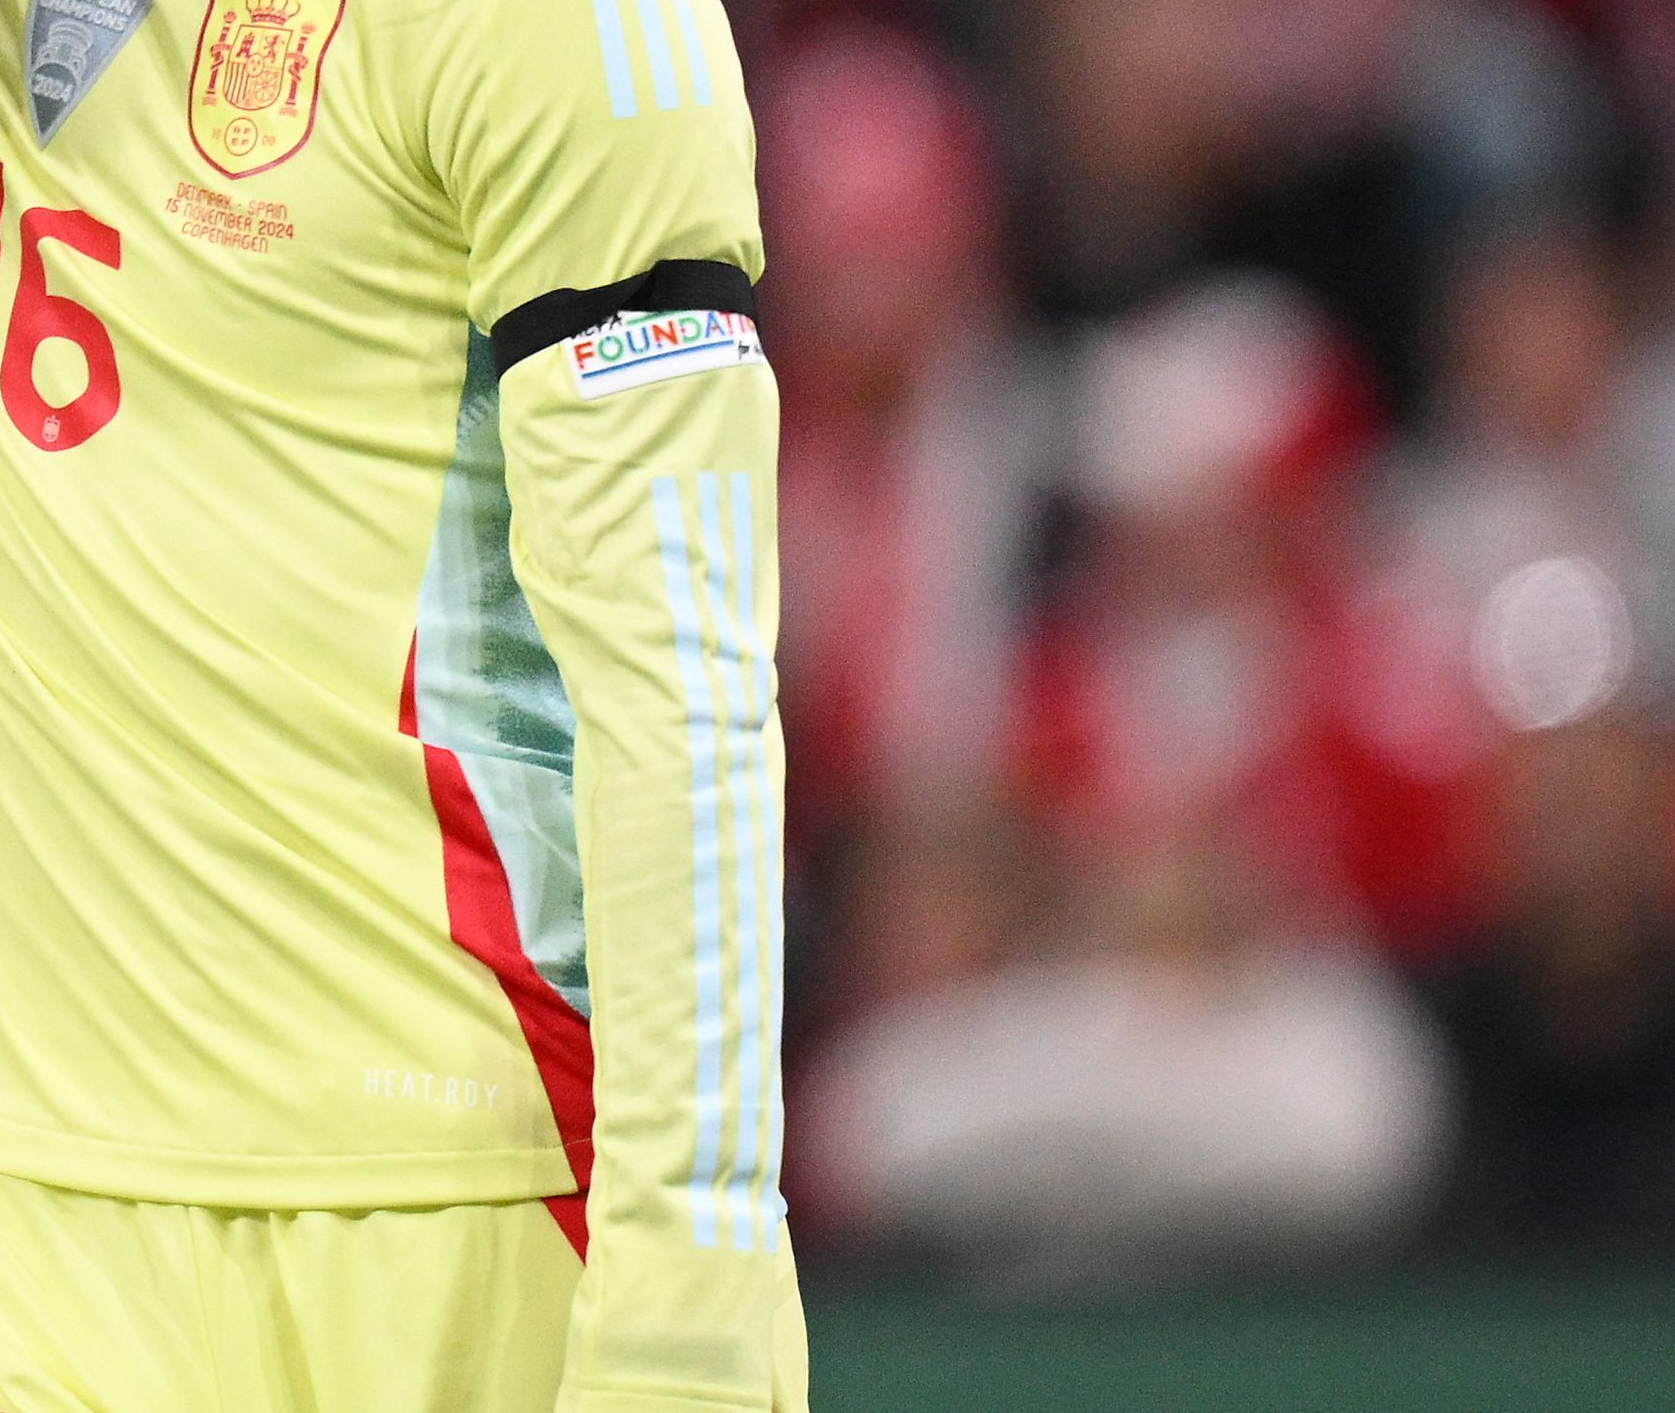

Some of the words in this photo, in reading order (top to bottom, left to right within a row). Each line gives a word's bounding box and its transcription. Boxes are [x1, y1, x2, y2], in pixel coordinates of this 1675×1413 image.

[165, 198, 180, 213] 15
[183, 202, 253, 231] NOVEMBER
[257, 220, 294, 240] 2024
[177, 182, 232, 207] DENMARK
[248, 199, 287, 220] SPAIN
[181, 221, 269, 254] COPENHAGEN
